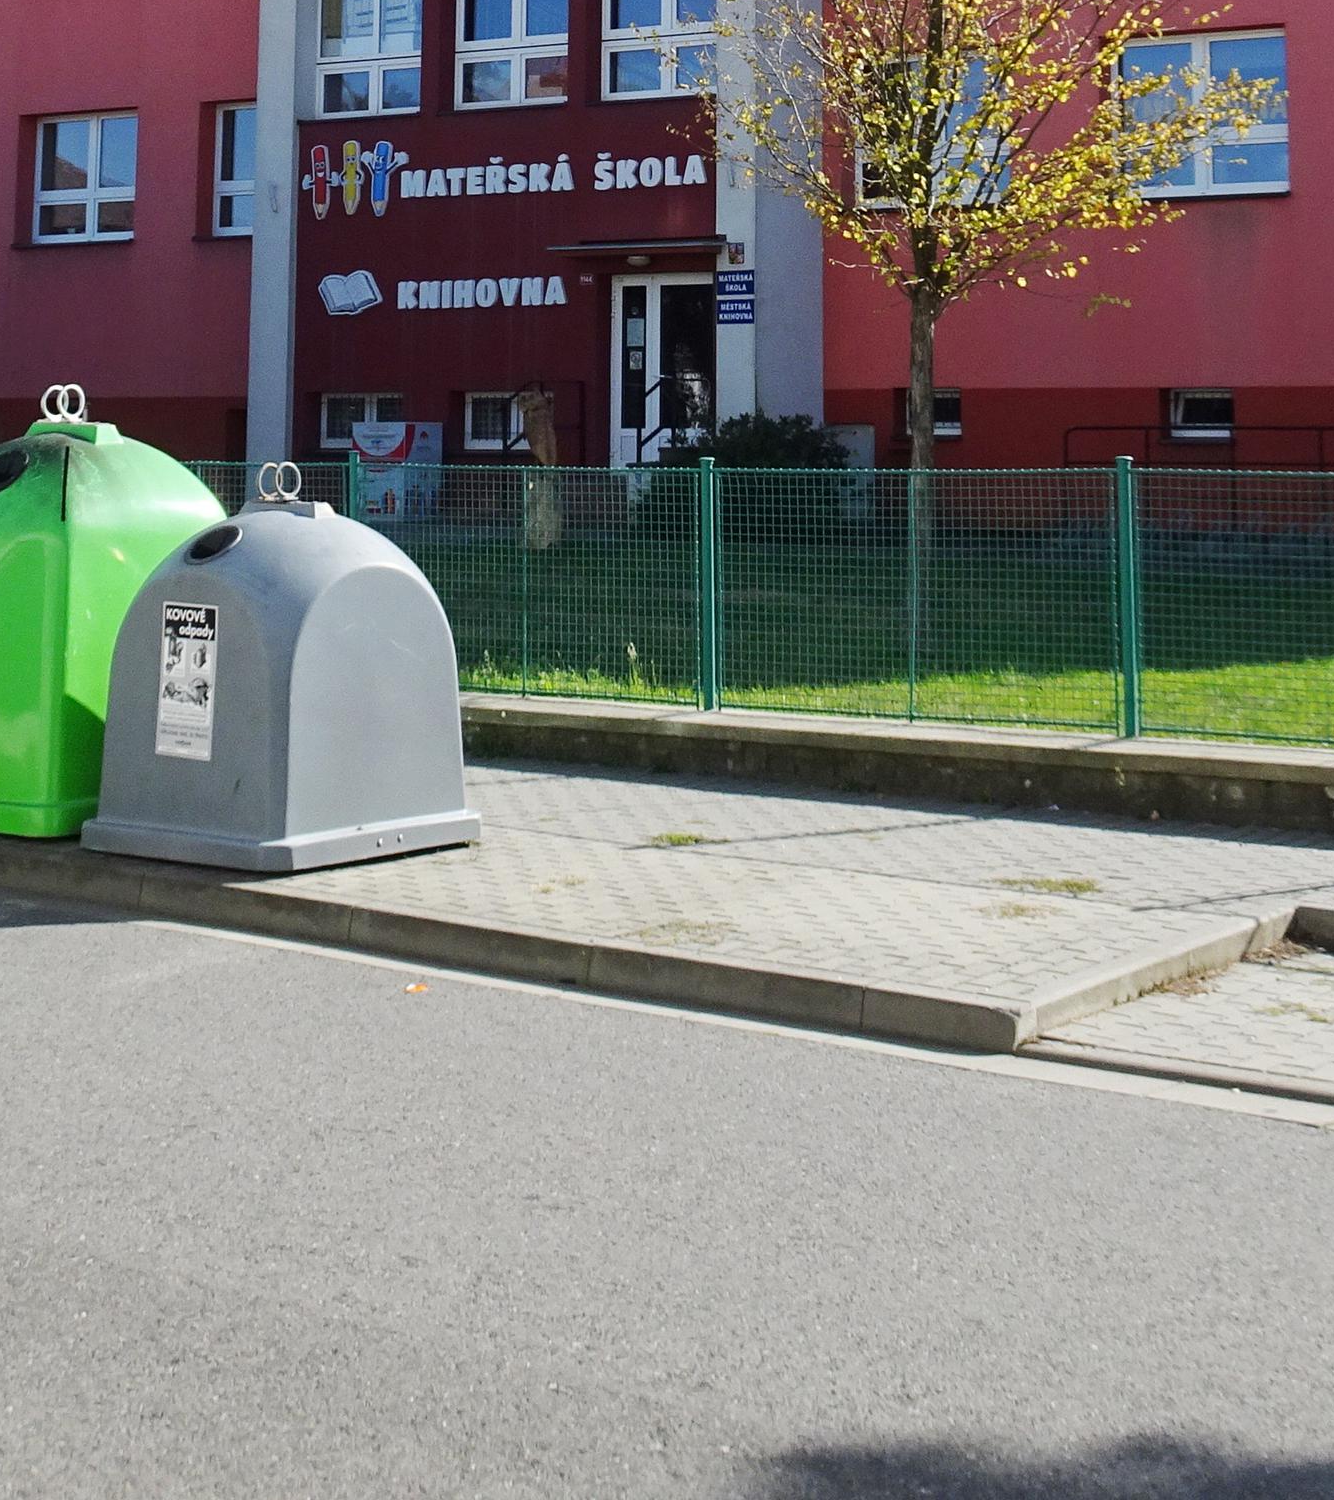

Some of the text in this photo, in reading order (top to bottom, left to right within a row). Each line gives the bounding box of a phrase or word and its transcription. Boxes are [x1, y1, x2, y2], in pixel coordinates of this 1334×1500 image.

[400, 152, 708, 198] MATEŘSKÁ ŠKOLA
[718, 273, 754, 282] MATEŘSKÁ
[397, 275, 568, 310] KNIHOVNA
[725, 283, 747, 292] ŠKOLA
[720, 302, 752, 311] MĚSTSKÁ
[718, 312, 753, 320] KNIHOVNA
[166, 607, 206, 623] KOVOVÉ
[179, 623, 214, 640] odpady
